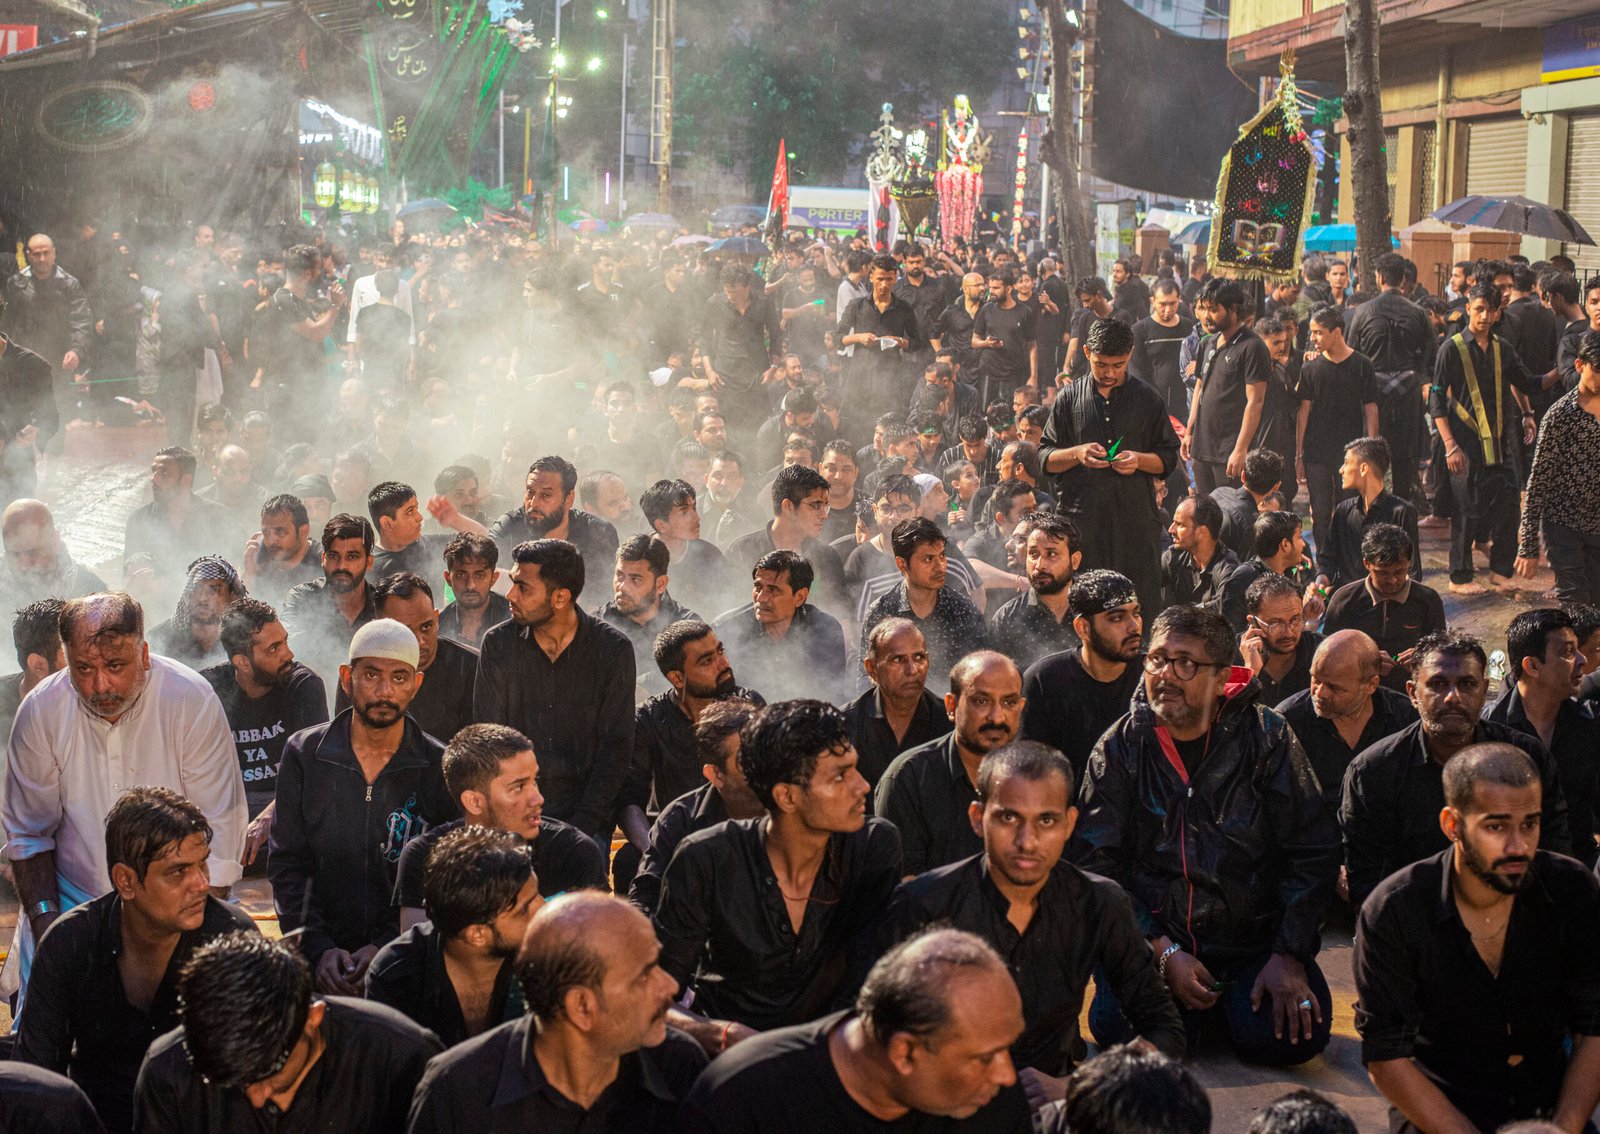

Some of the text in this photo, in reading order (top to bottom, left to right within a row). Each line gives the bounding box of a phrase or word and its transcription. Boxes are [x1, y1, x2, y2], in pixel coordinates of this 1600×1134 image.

[808, 207, 863, 221] PORTER
[243, 747, 268, 762] YA
[241, 762, 281, 781] SSA
